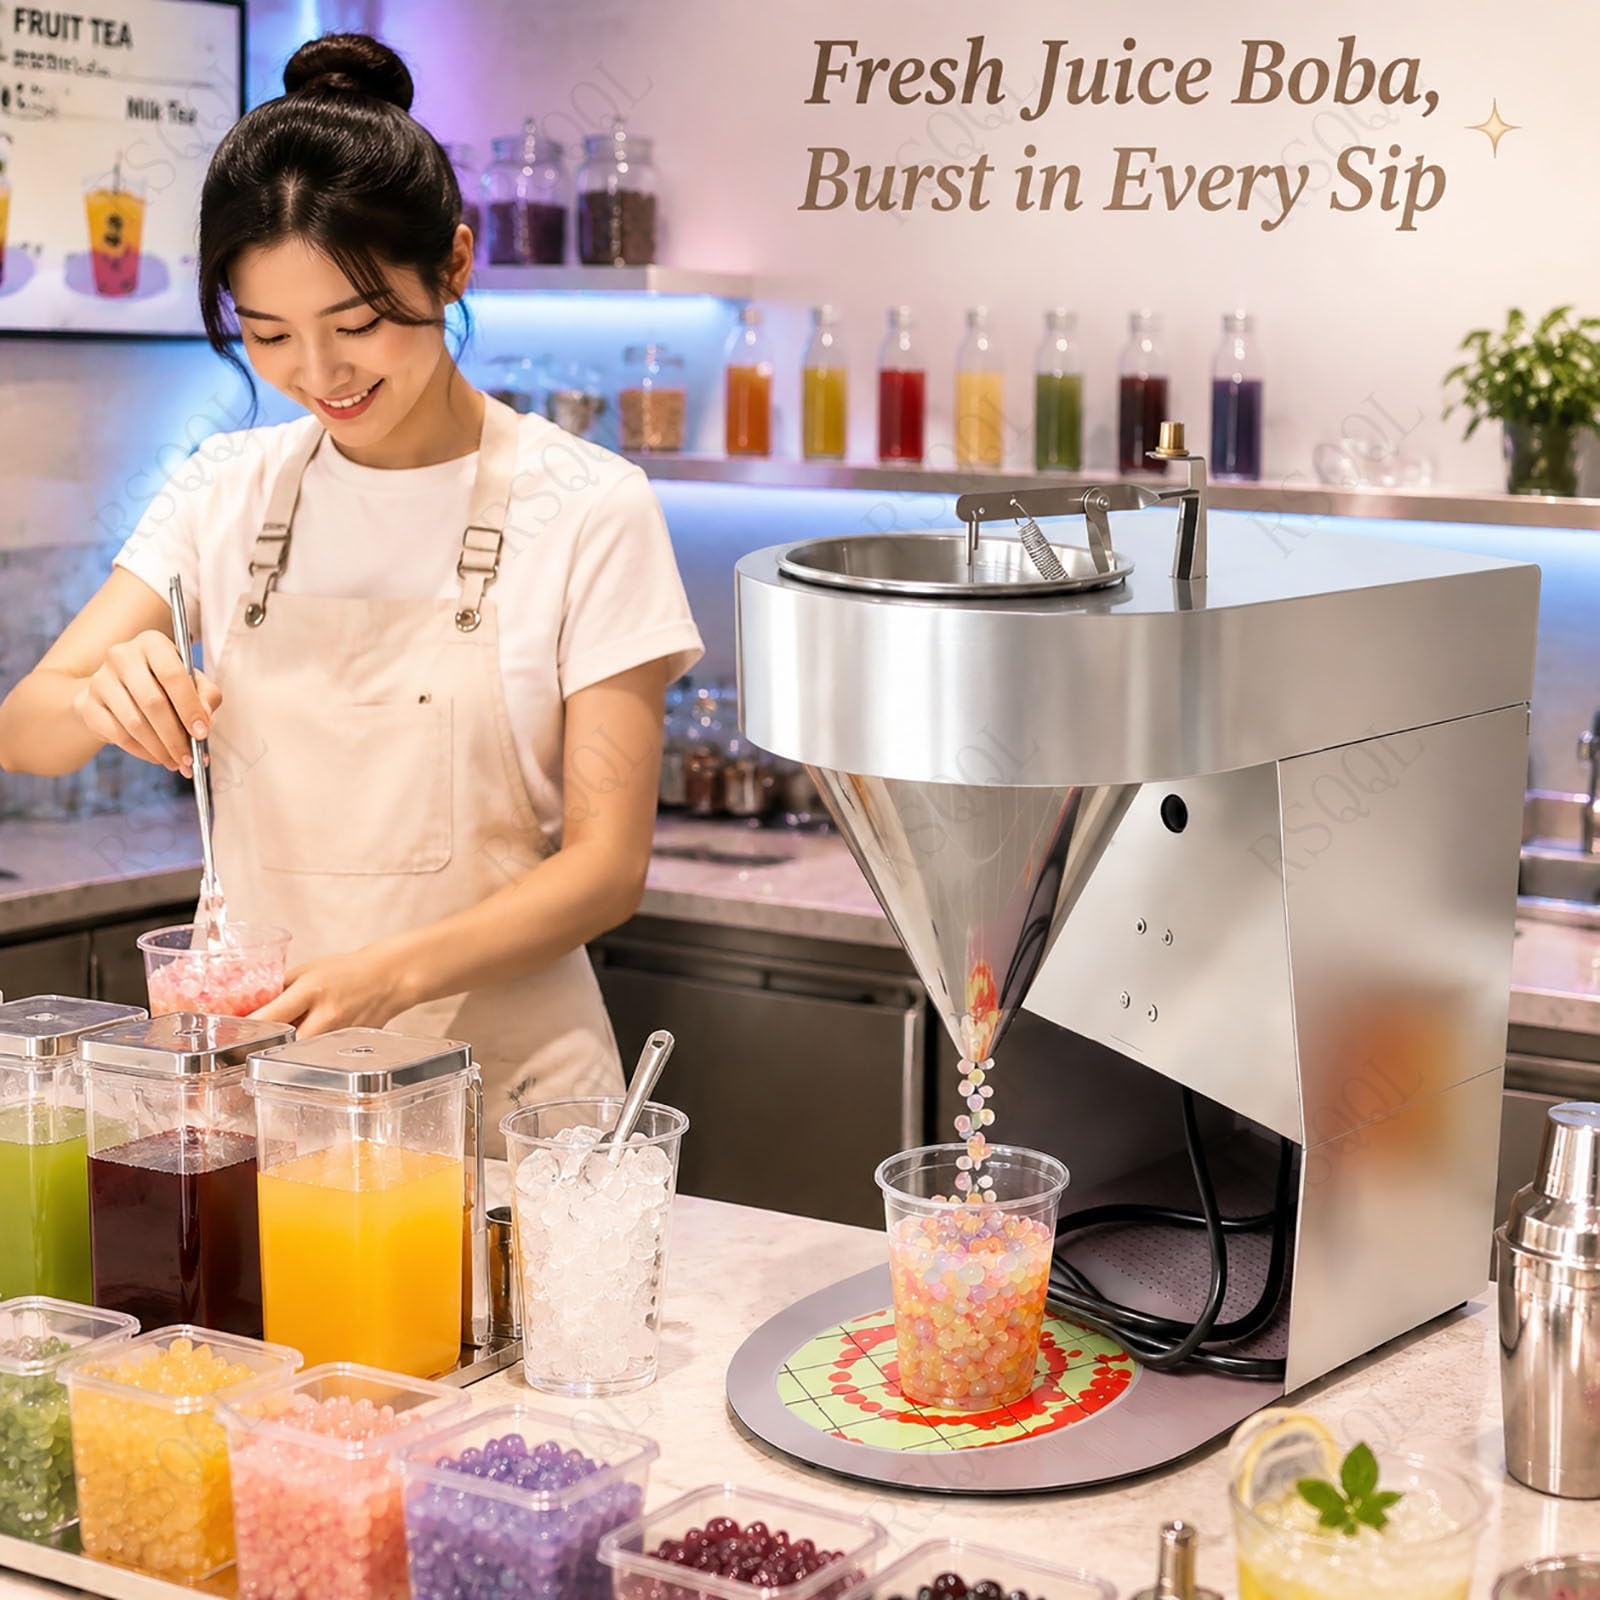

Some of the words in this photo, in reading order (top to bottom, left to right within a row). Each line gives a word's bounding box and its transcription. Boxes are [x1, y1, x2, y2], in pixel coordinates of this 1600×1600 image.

[14, 7, 83, 41] FRUIT
[90, 18, 133, 49] TEA
[126, 96, 162, 121] Milk
